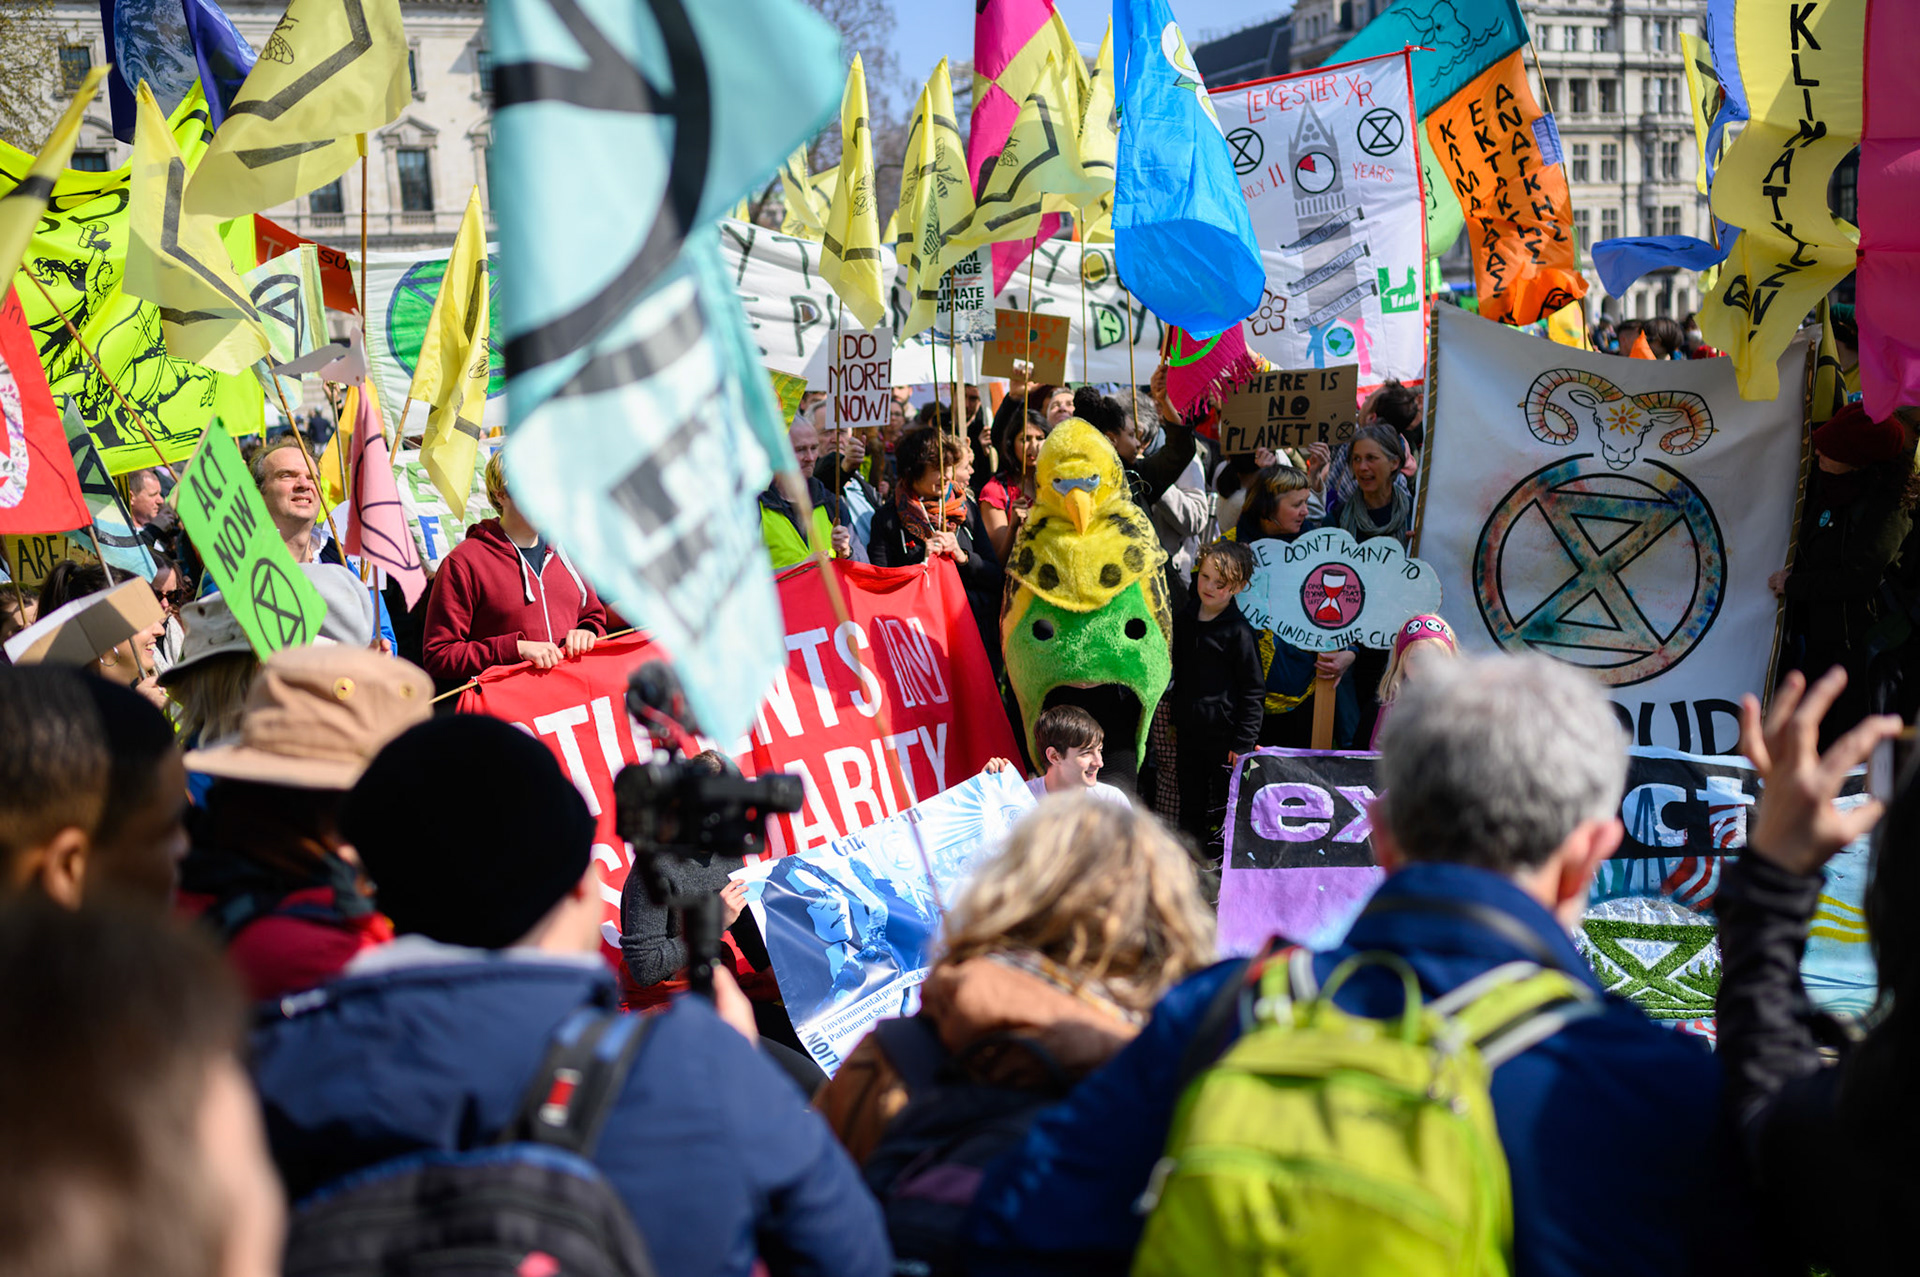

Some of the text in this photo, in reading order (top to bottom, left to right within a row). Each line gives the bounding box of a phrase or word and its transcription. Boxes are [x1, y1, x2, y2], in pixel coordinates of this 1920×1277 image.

[1247, 74, 1376, 124] LEICESTER XR
[1242, 179, 1266, 201] NLY
[1352, 162, 1395, 183] YEARS
[939, 277, 952, 289] OT
[943, 262, 982, 276] ANGE
[936, 299, 984, 313] HANGE
[938, 287, 985, 301] IMATE
[844, 334, 877, 359] DO
[829, 358, 892, 393] MORE!
[1320, 372, 1340, 391] IS
[834, 394, 890, 424] NOW!
[1268, 395, 1311, 417] NO
[190, 441, 227, 521] ACT
[213, 485, 257, 583] NOW
[1252, 534, 1421, 580] E DON'T WANT TO
[1241, 604, 1272, 630] LIVE
[1277, 621, 1324, 648] UNDER
[1330, 628, 1364, 648] THIS
[875, 616, 949, 708] IN
[820, 992, 883, 1032] Environmental
[828, 1012, 877, 1043] Parliament
